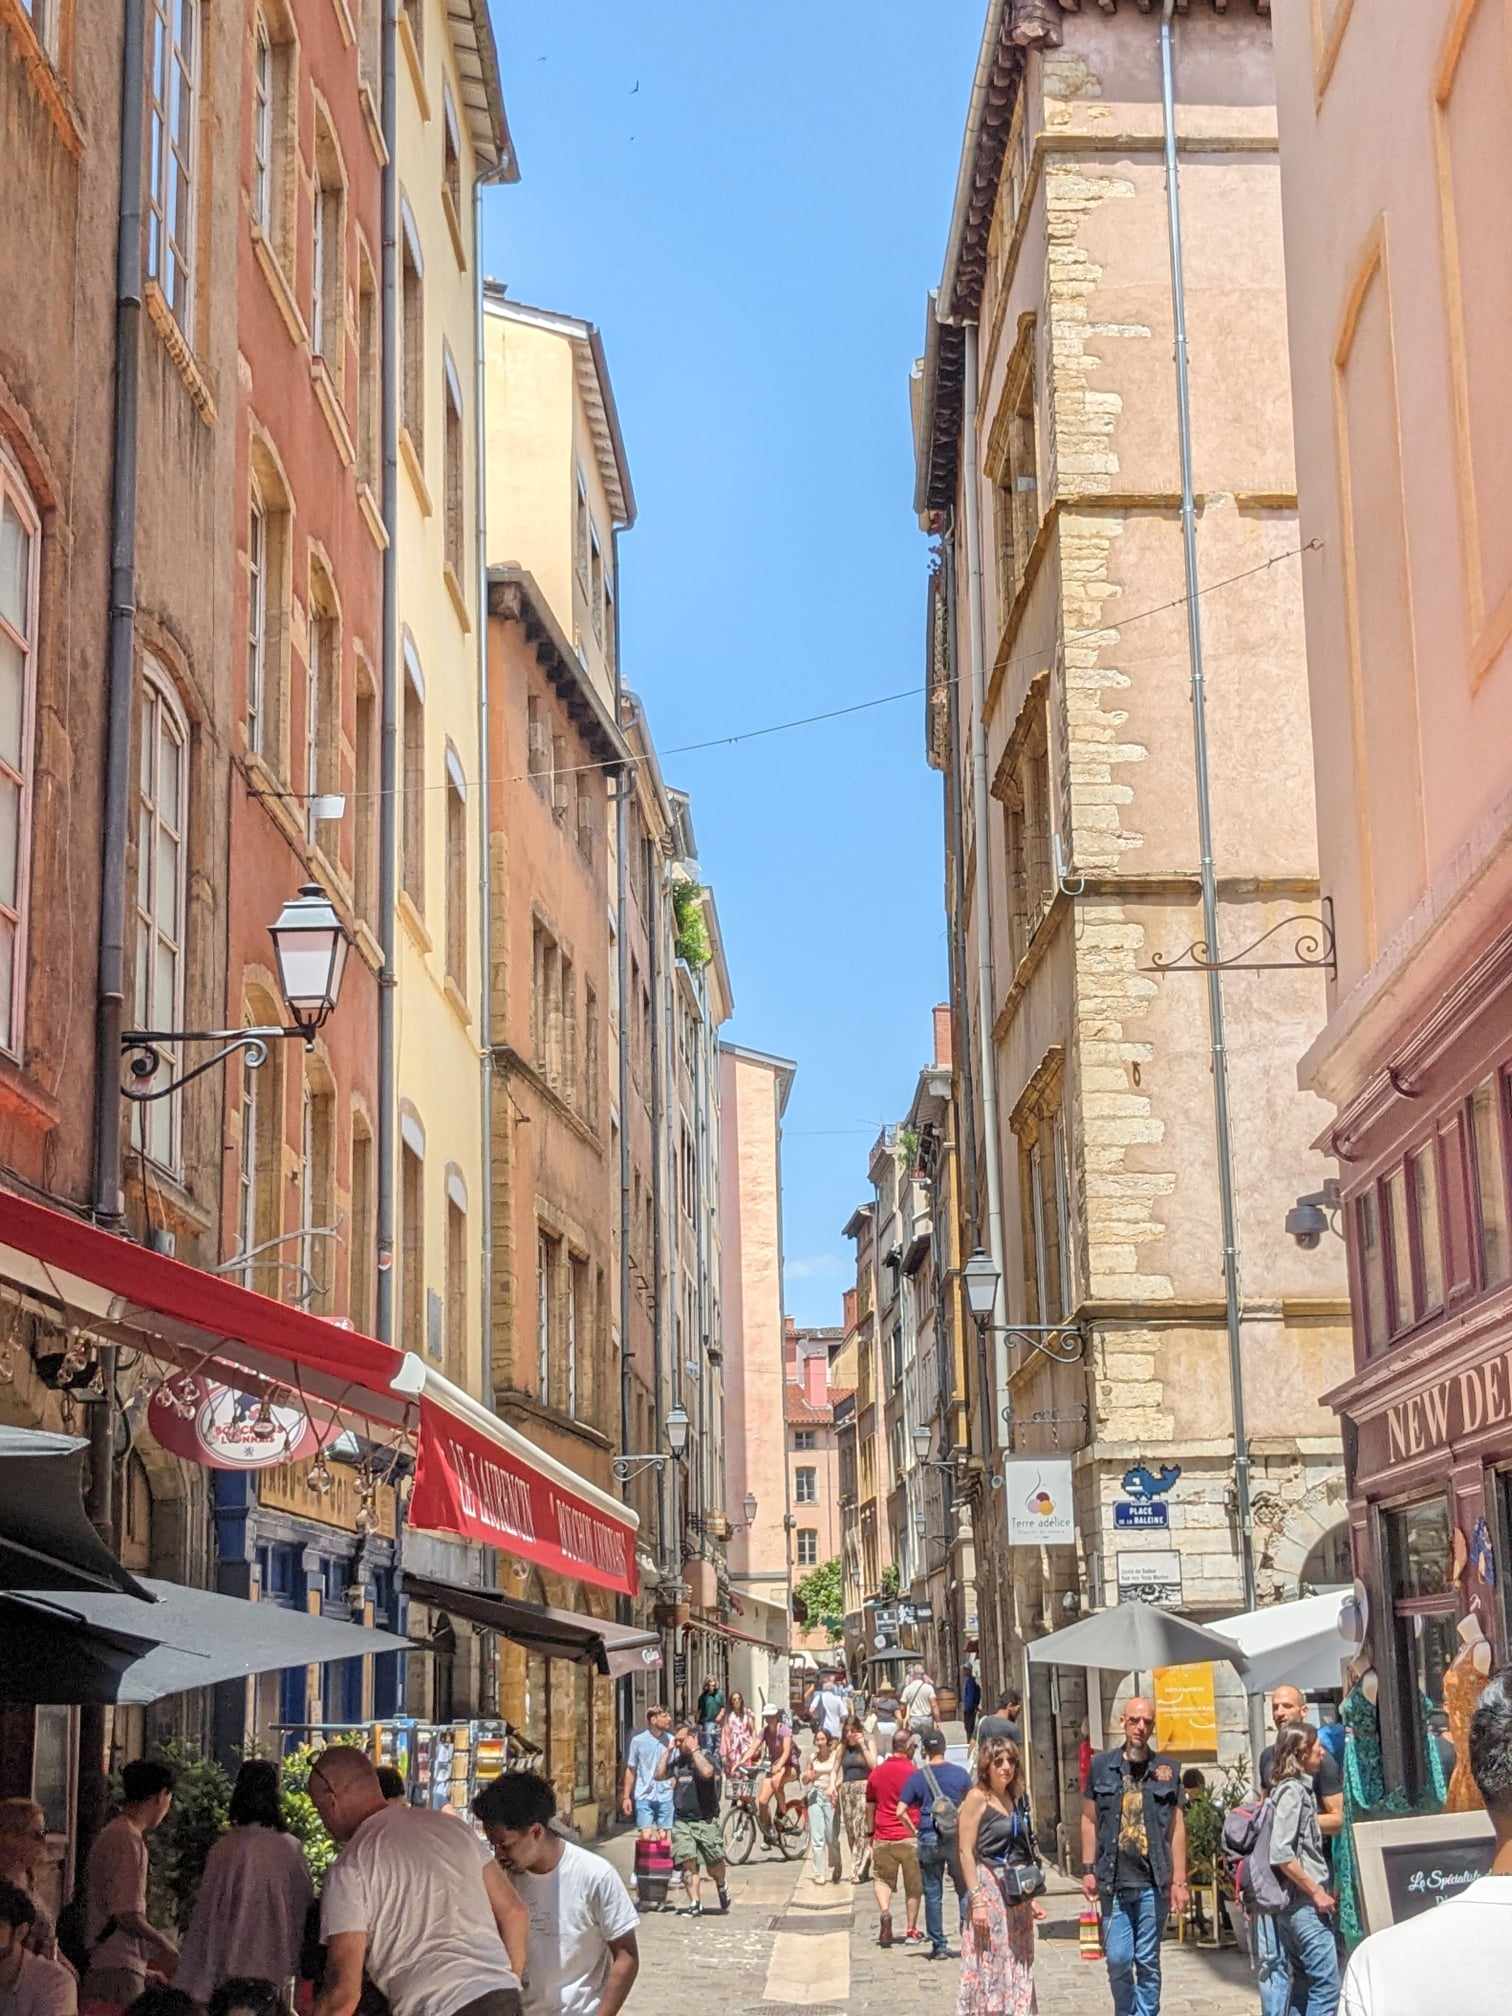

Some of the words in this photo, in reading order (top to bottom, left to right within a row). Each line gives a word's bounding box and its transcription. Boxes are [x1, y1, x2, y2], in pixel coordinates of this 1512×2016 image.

[1386, 1380, 1450, 1463] NEW
[1129, 1506, 1153, 1516] PLACE
[1012, 1517, 1035, 1528] Terre
[1134, 1516, 1164, 1525] BALEINE
[1408, 1871, 1425, 1892] Le
